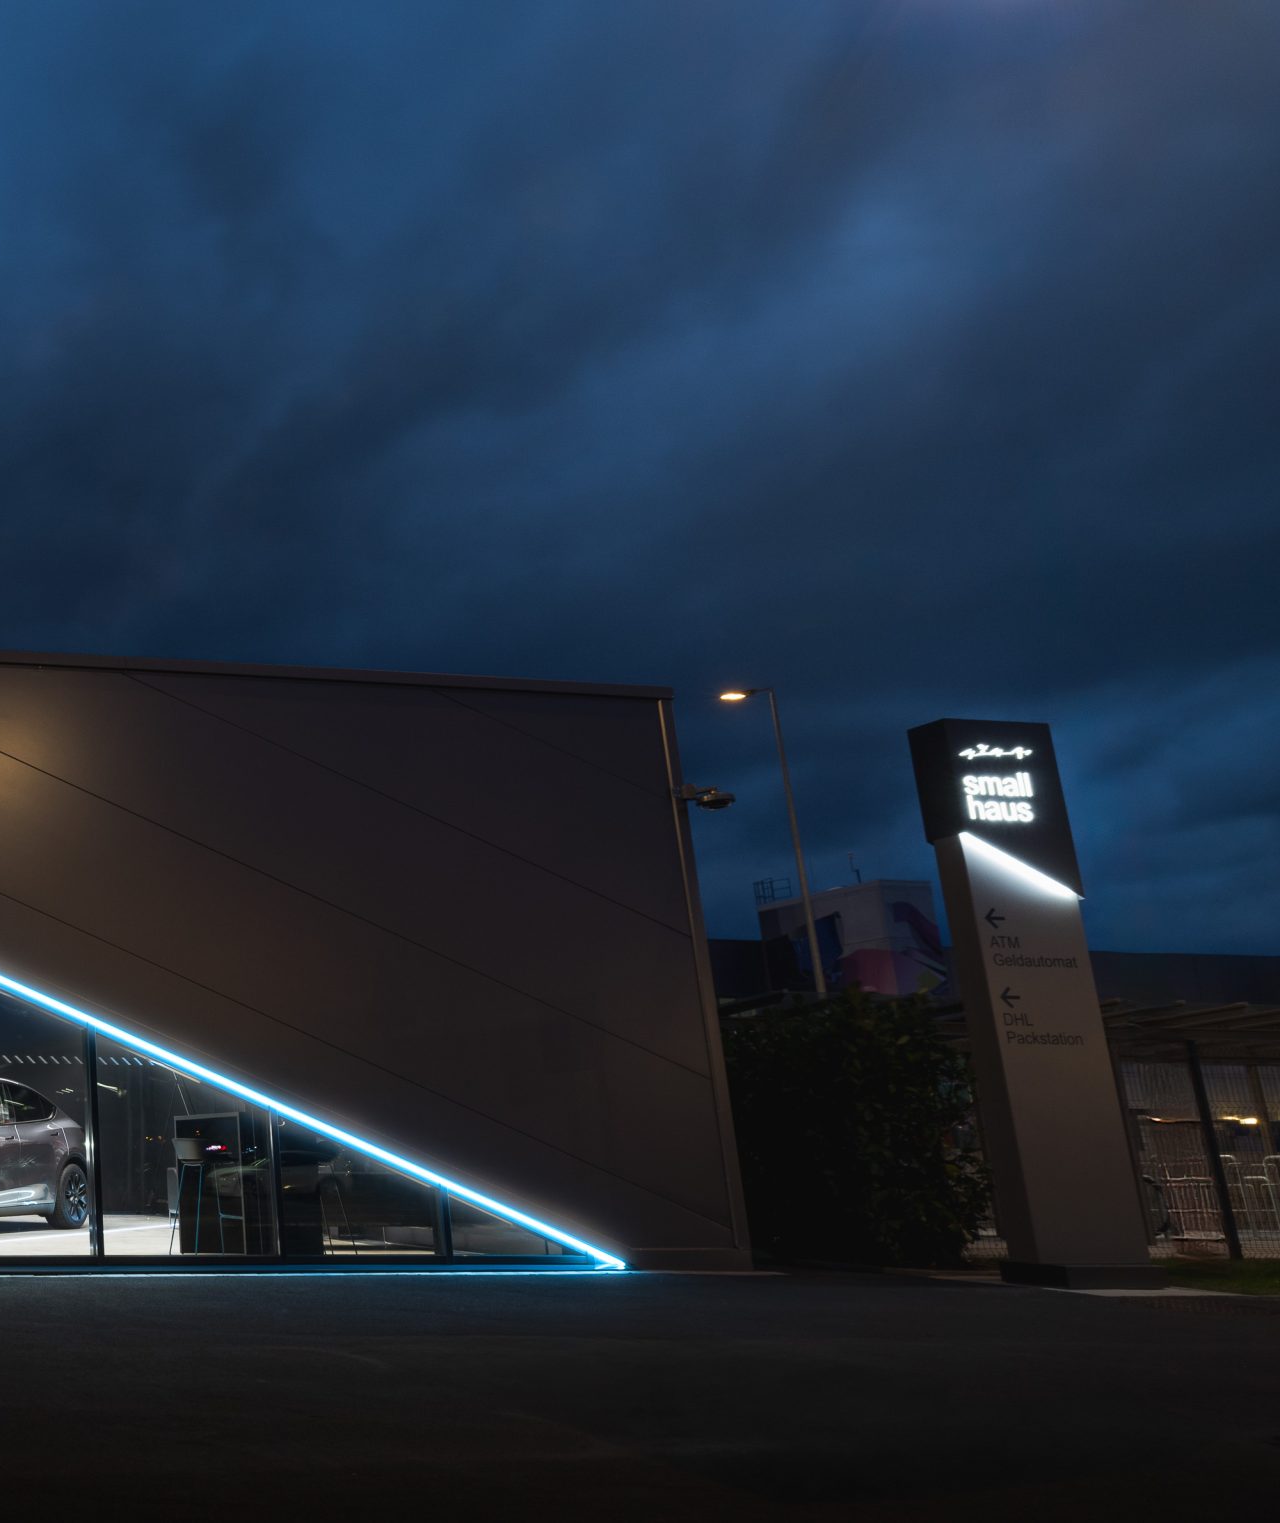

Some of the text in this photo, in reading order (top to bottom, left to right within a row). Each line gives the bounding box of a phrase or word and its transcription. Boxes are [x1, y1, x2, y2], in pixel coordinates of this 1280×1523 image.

[962, 772, 1034, 798] small
[966, 794, 1035, 823] haus
[990, 936, 1020, 949] ATM
[992, 953, 1078, 969] Geldautomat
[1002, 1012, 1034, 1027] DHL
[1006, 1031, 1084, 1046] Packstation
